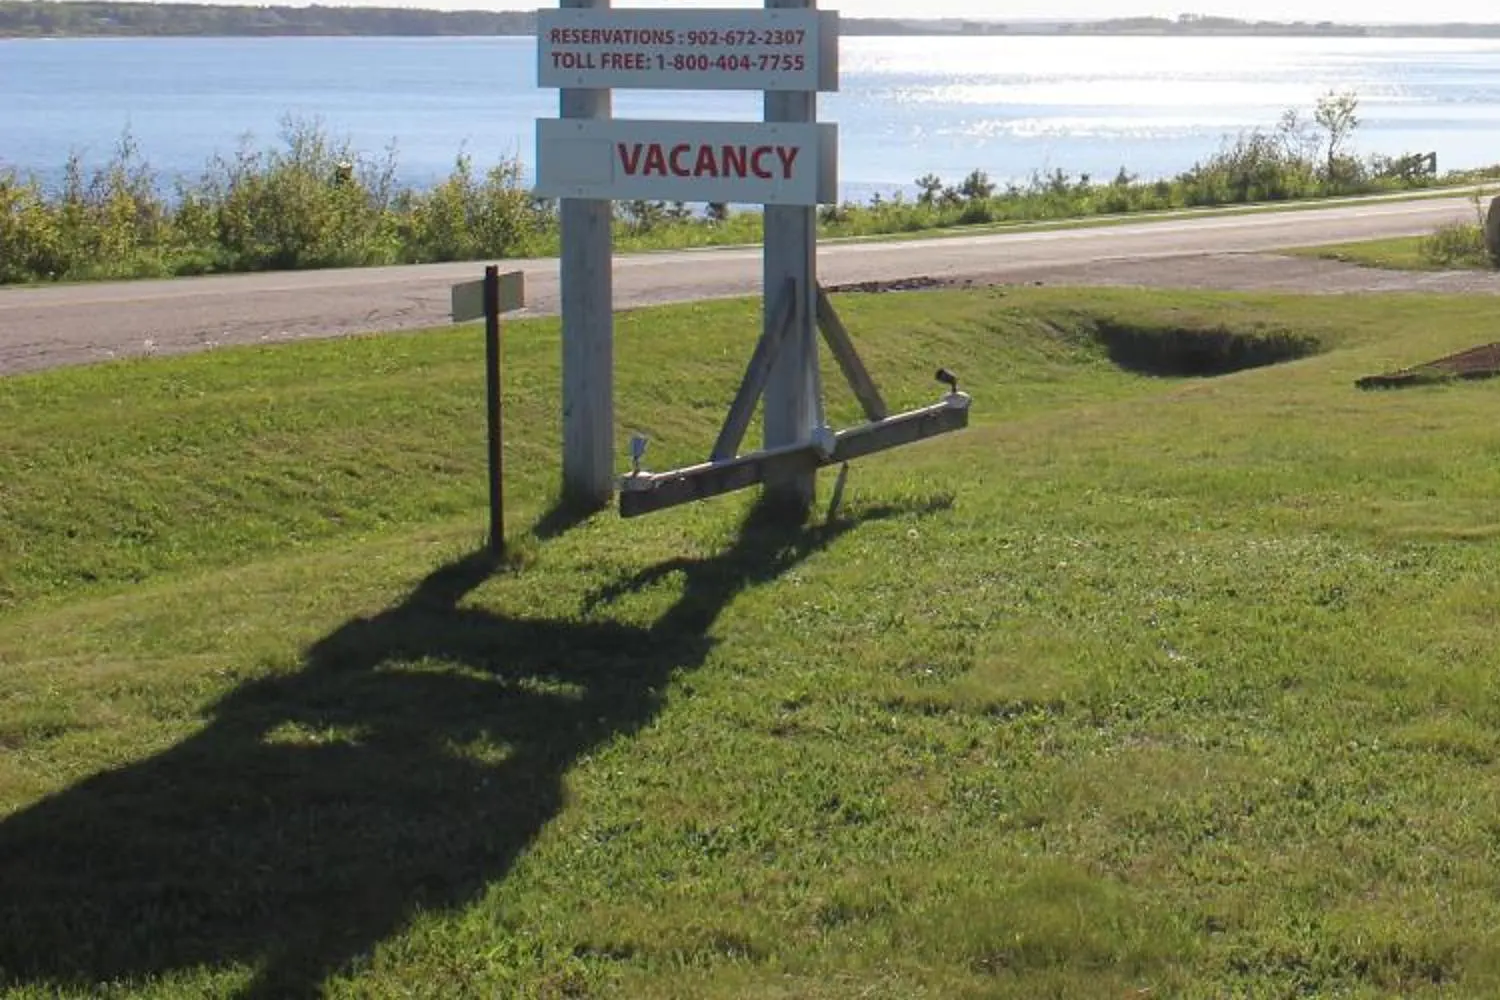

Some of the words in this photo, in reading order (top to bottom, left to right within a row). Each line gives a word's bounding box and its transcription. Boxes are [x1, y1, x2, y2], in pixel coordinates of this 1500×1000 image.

[687, 30, 805, 45] 902-672-2307
[551, 52, 595, 69] TOLL
[601, 52, 651, 70] FREE:
[656, 53, 805, 71] 1-800-404-7755
[617, 143, 800, 179] VACANCY
